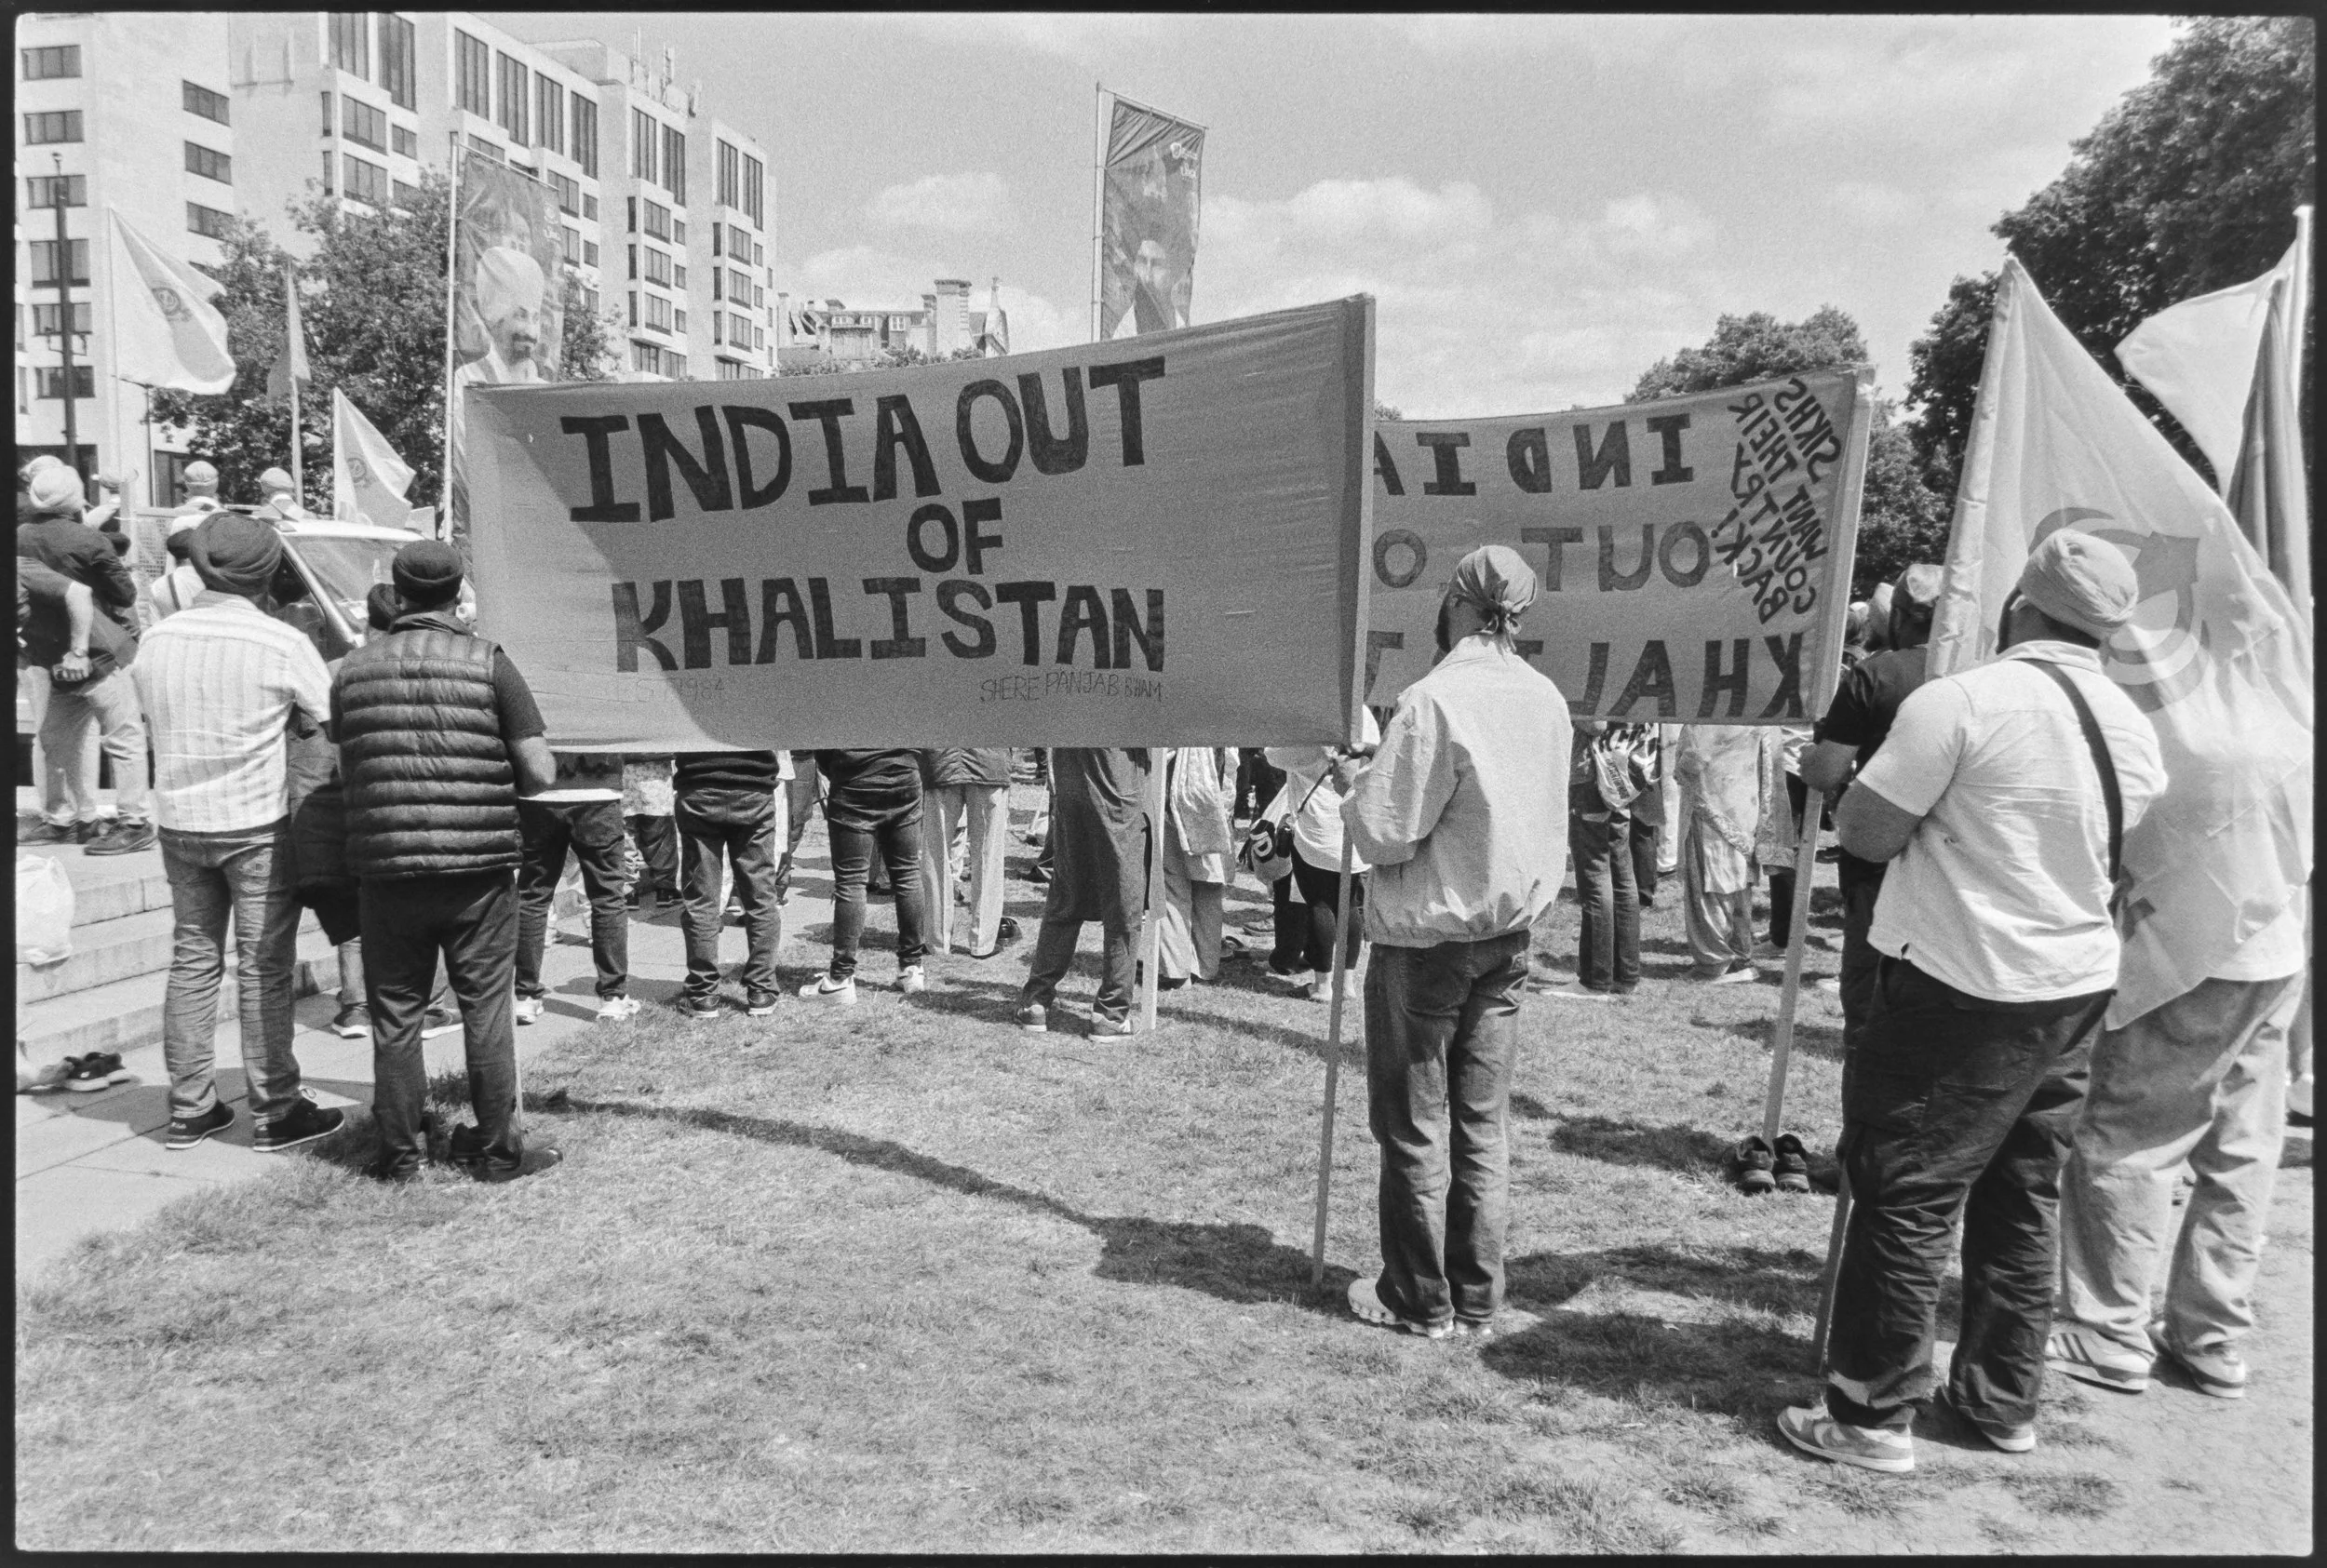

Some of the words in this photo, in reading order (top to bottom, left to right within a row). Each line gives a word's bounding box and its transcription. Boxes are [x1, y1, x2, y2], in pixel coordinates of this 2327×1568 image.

[559, 395, 942, 523] INDIA
[957, 355, 1165, 484] OUT
[907, 497, 1002, 574] OF
[610, 575, 1165, 673] KHALISTAN
[980, 675, 1041, 703] SHERE
[1043, 670, 1120, 697] PANJAB
